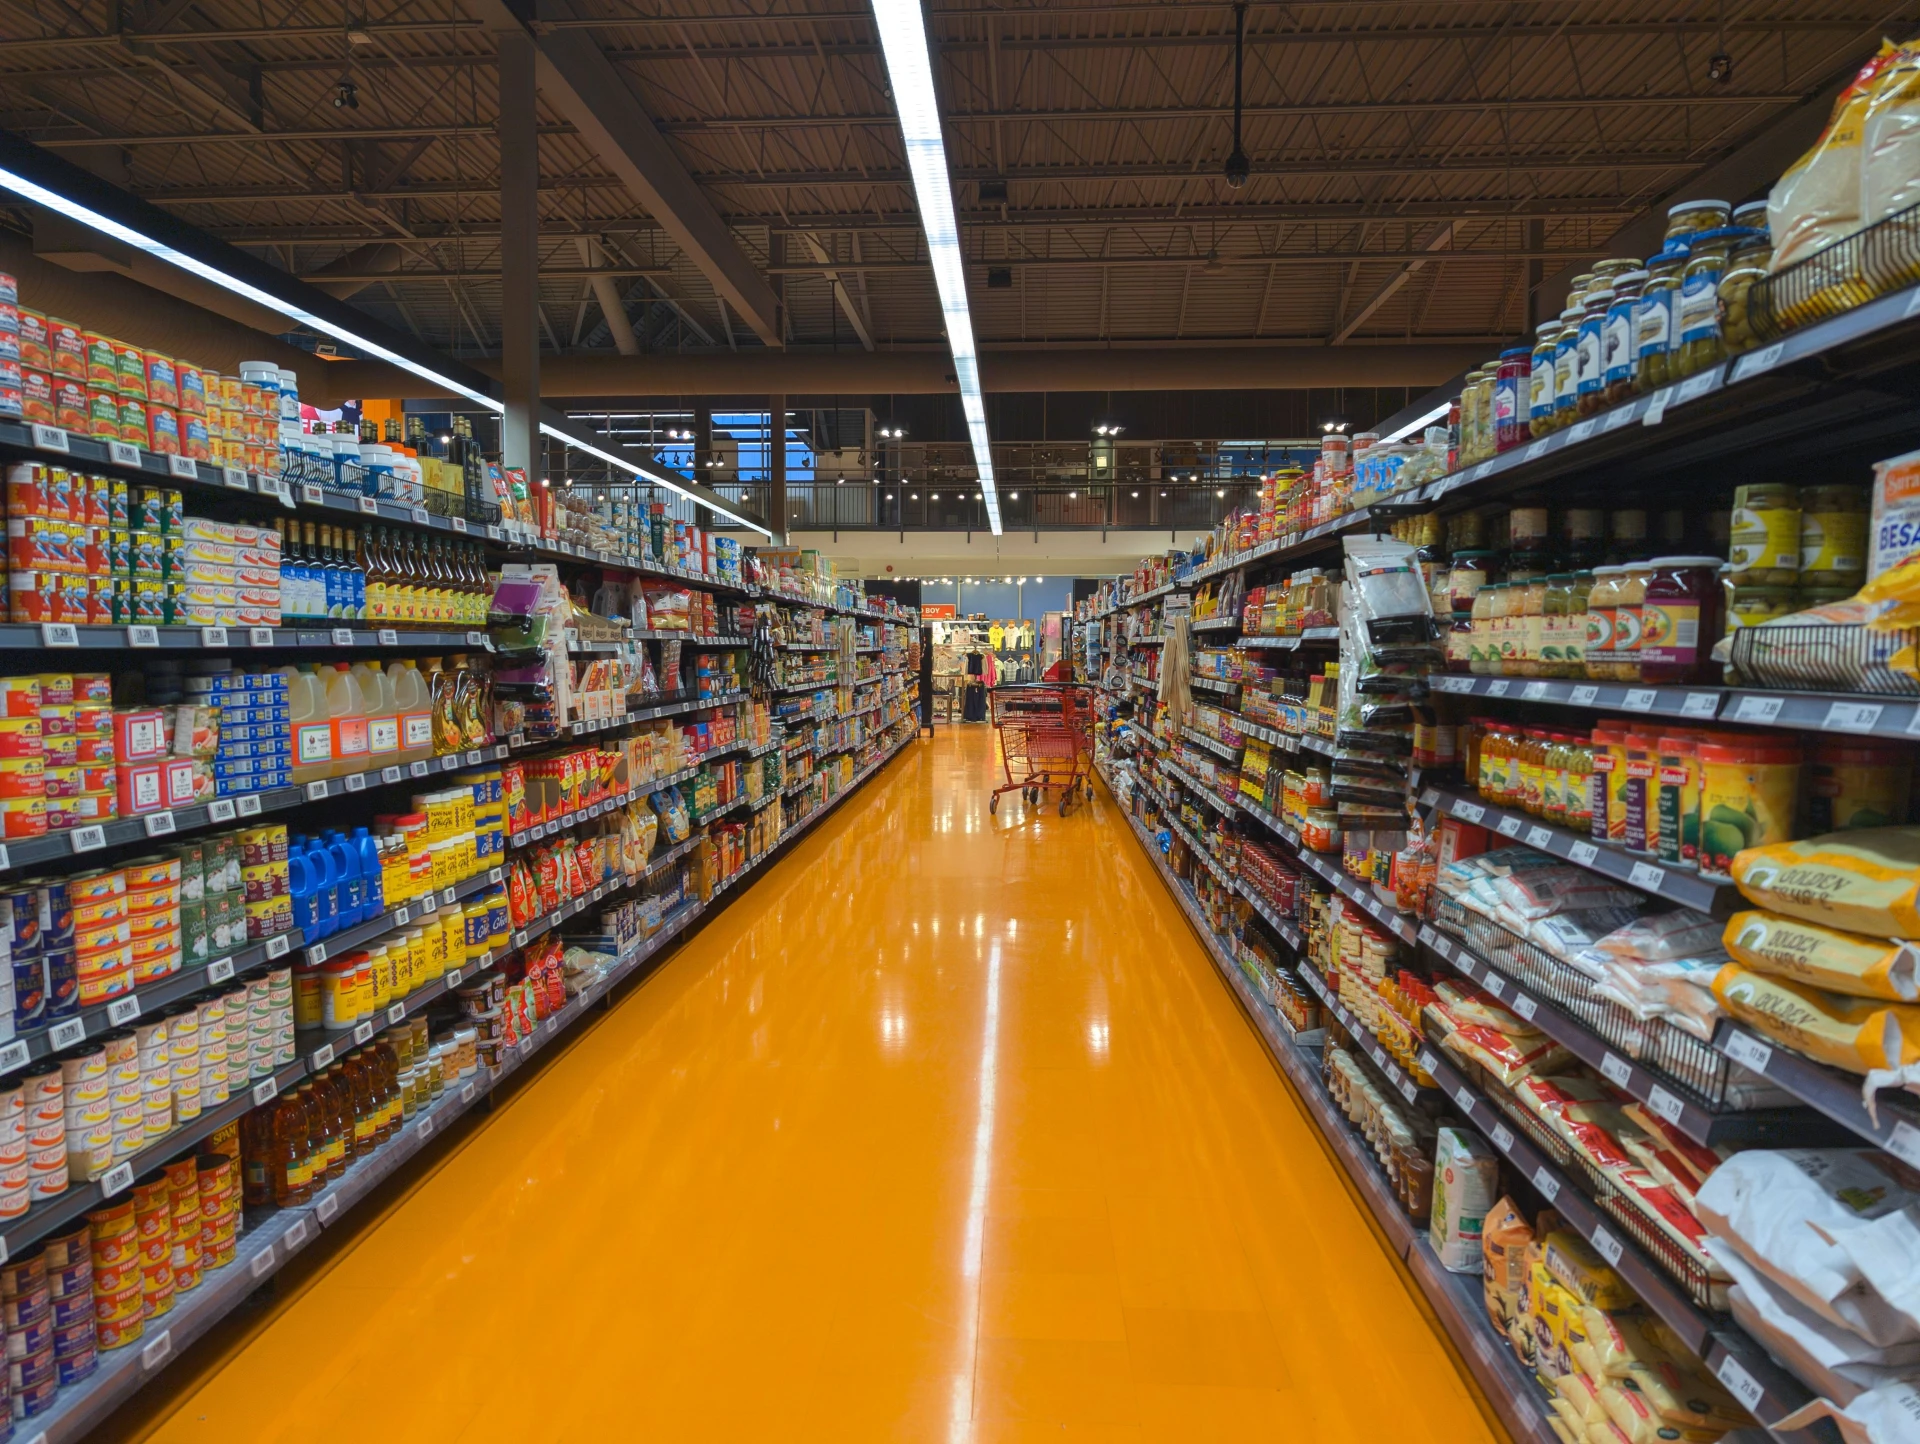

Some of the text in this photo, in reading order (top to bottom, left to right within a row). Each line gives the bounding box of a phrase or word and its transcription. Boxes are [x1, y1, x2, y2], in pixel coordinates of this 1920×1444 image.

[1778, 868, 1852, 892] GOLDEN
[1767, 929, 1826, 954] GOLDEN
[1754, 992, 1819, 1026] GOLDEN
[213, 1124, 237, 1145] SPAM
